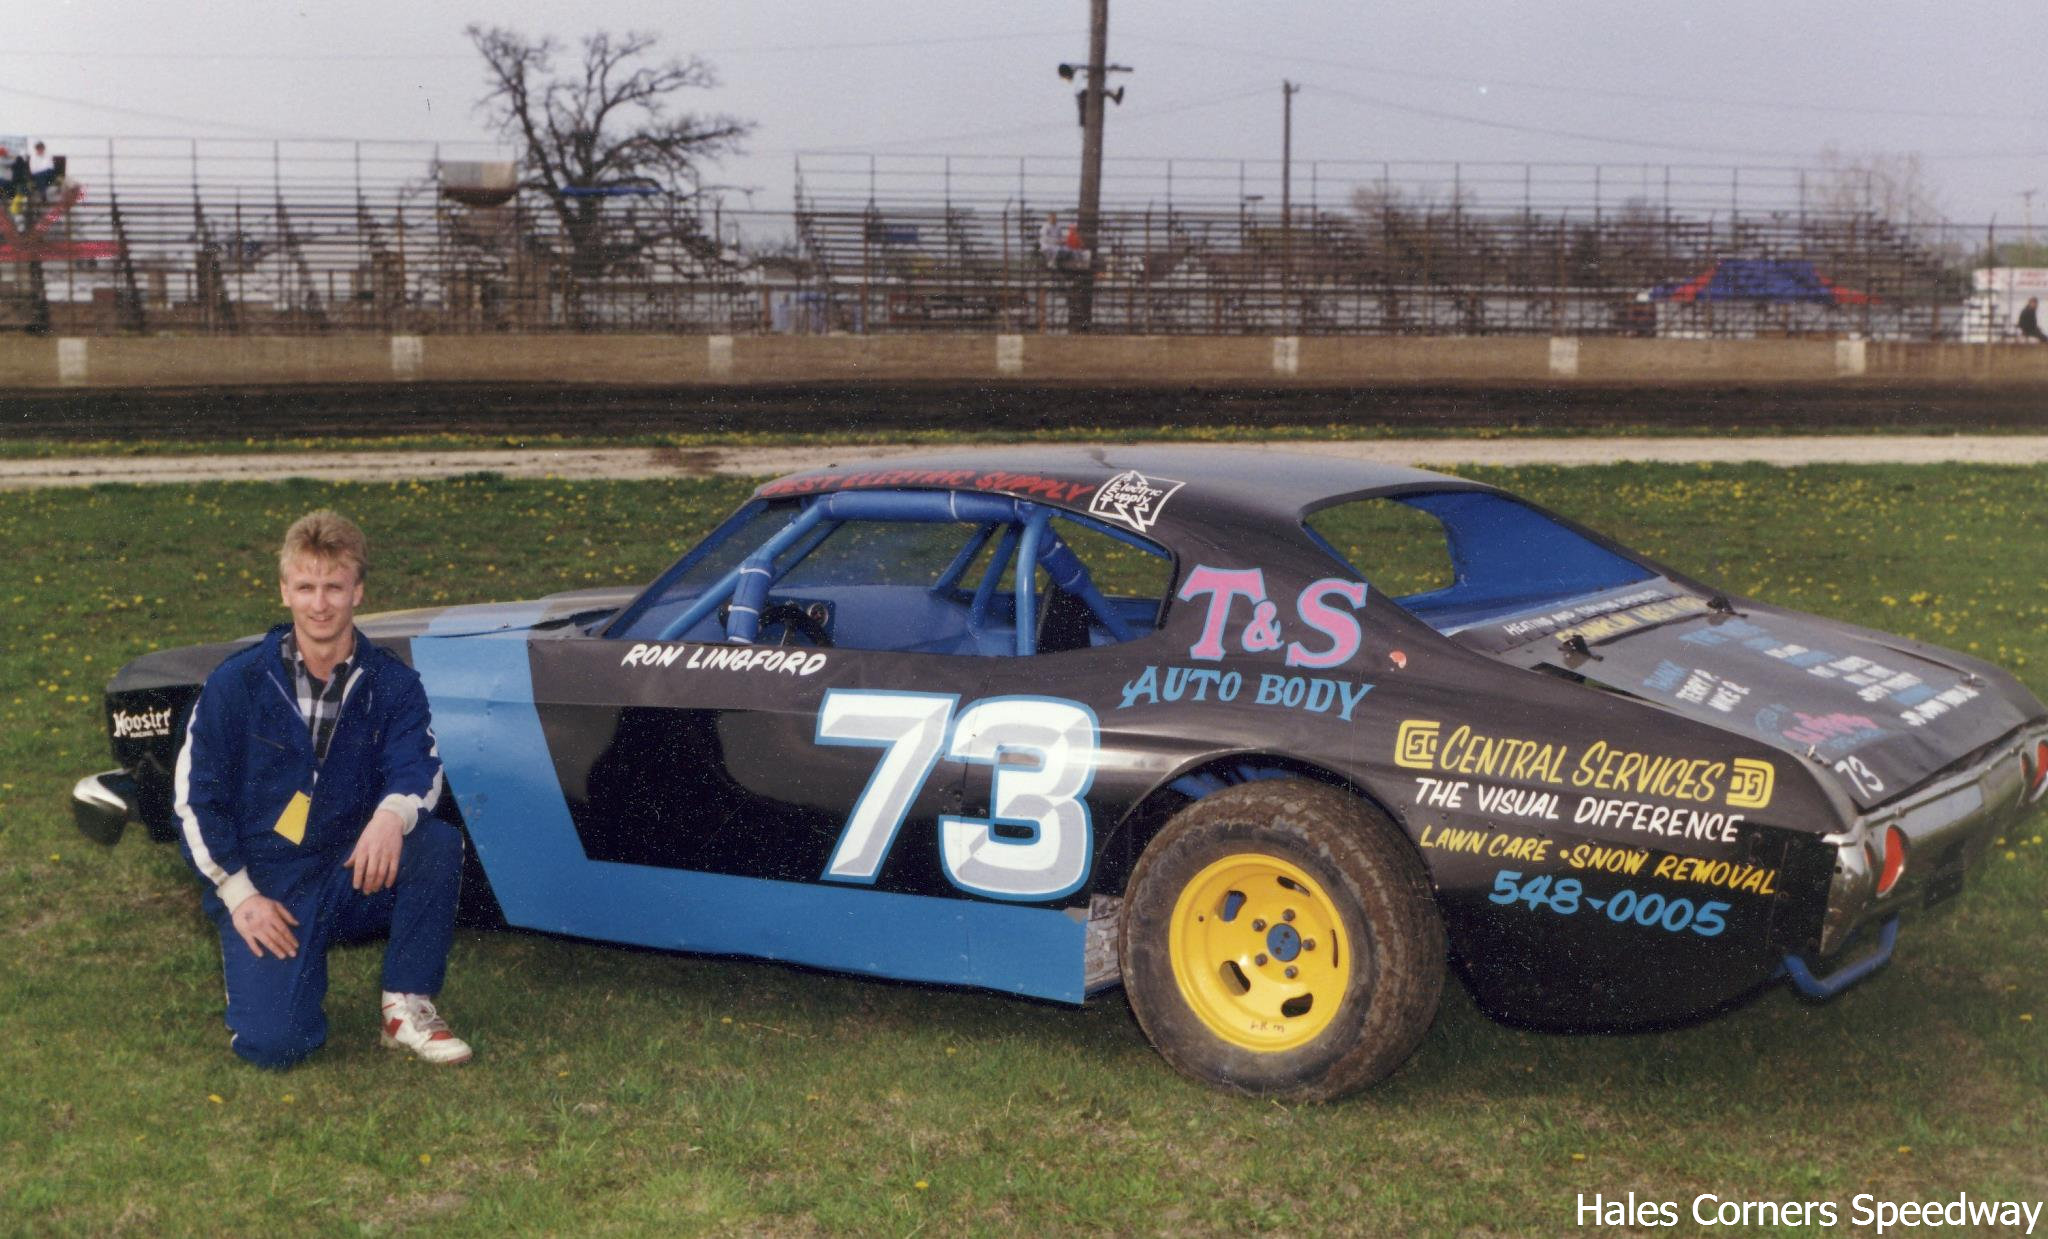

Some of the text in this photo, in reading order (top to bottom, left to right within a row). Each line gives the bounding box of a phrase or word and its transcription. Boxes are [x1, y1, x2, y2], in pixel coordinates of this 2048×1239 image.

[976, 471, 1096, 501] SUPPLY
[1176, 564, 1369, 669] T&S
[620, 643, 828, 676] RON LINGFORD
[1116, 665, 1376, 722] AUTO BODY
[814, 687, 1100, 902] 73
[1440, 725, 1563, 784] CENTRAL
[1572, 740, 1725, 801] SERVICES
[1834, 755, 1885, 799] 73
[1415, 777, 1744, 842] THE VISUAL DIFFERENCE
[1420, 825, 1487, 855] LAWN
[1488, 833, 1553, 862] CARE
[1654, 855, 1778, 895] REMOVAL
[1488, 869, 1732, 938] 548-0005
